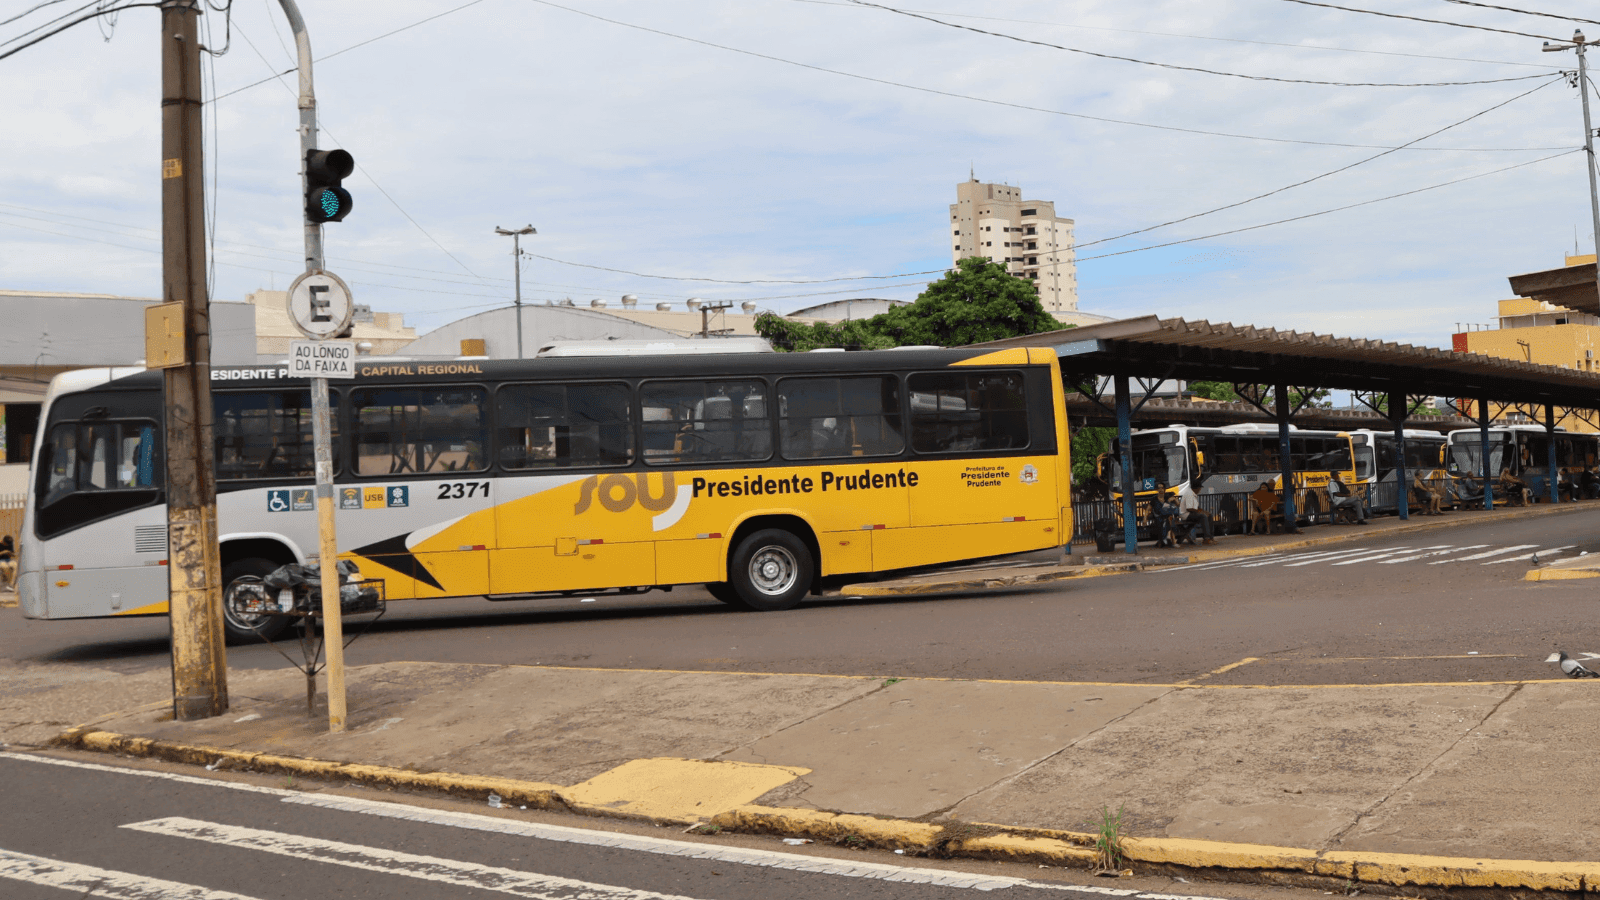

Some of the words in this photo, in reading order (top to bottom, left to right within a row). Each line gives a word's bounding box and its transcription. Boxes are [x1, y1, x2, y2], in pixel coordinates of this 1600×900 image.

[309, 285, 331, 322] E
[296, 346, 311, 357] AO
[313, 347, 349, 359] LONGO
[296, 360, 311, 371] DA
[315, 360, 348, 372] FAIXA
[361, 364, 415, 376] CAPITAL
[418, 364, 483, 375] REGIONAL
[961, 471, 1010, 480] Presidente
[692, 473, 814, 498] Presidente
[820, 468, 919, 492] Prudente
[437, 482, 491, 500] 2371
[364, 493, 384, 502] USB
